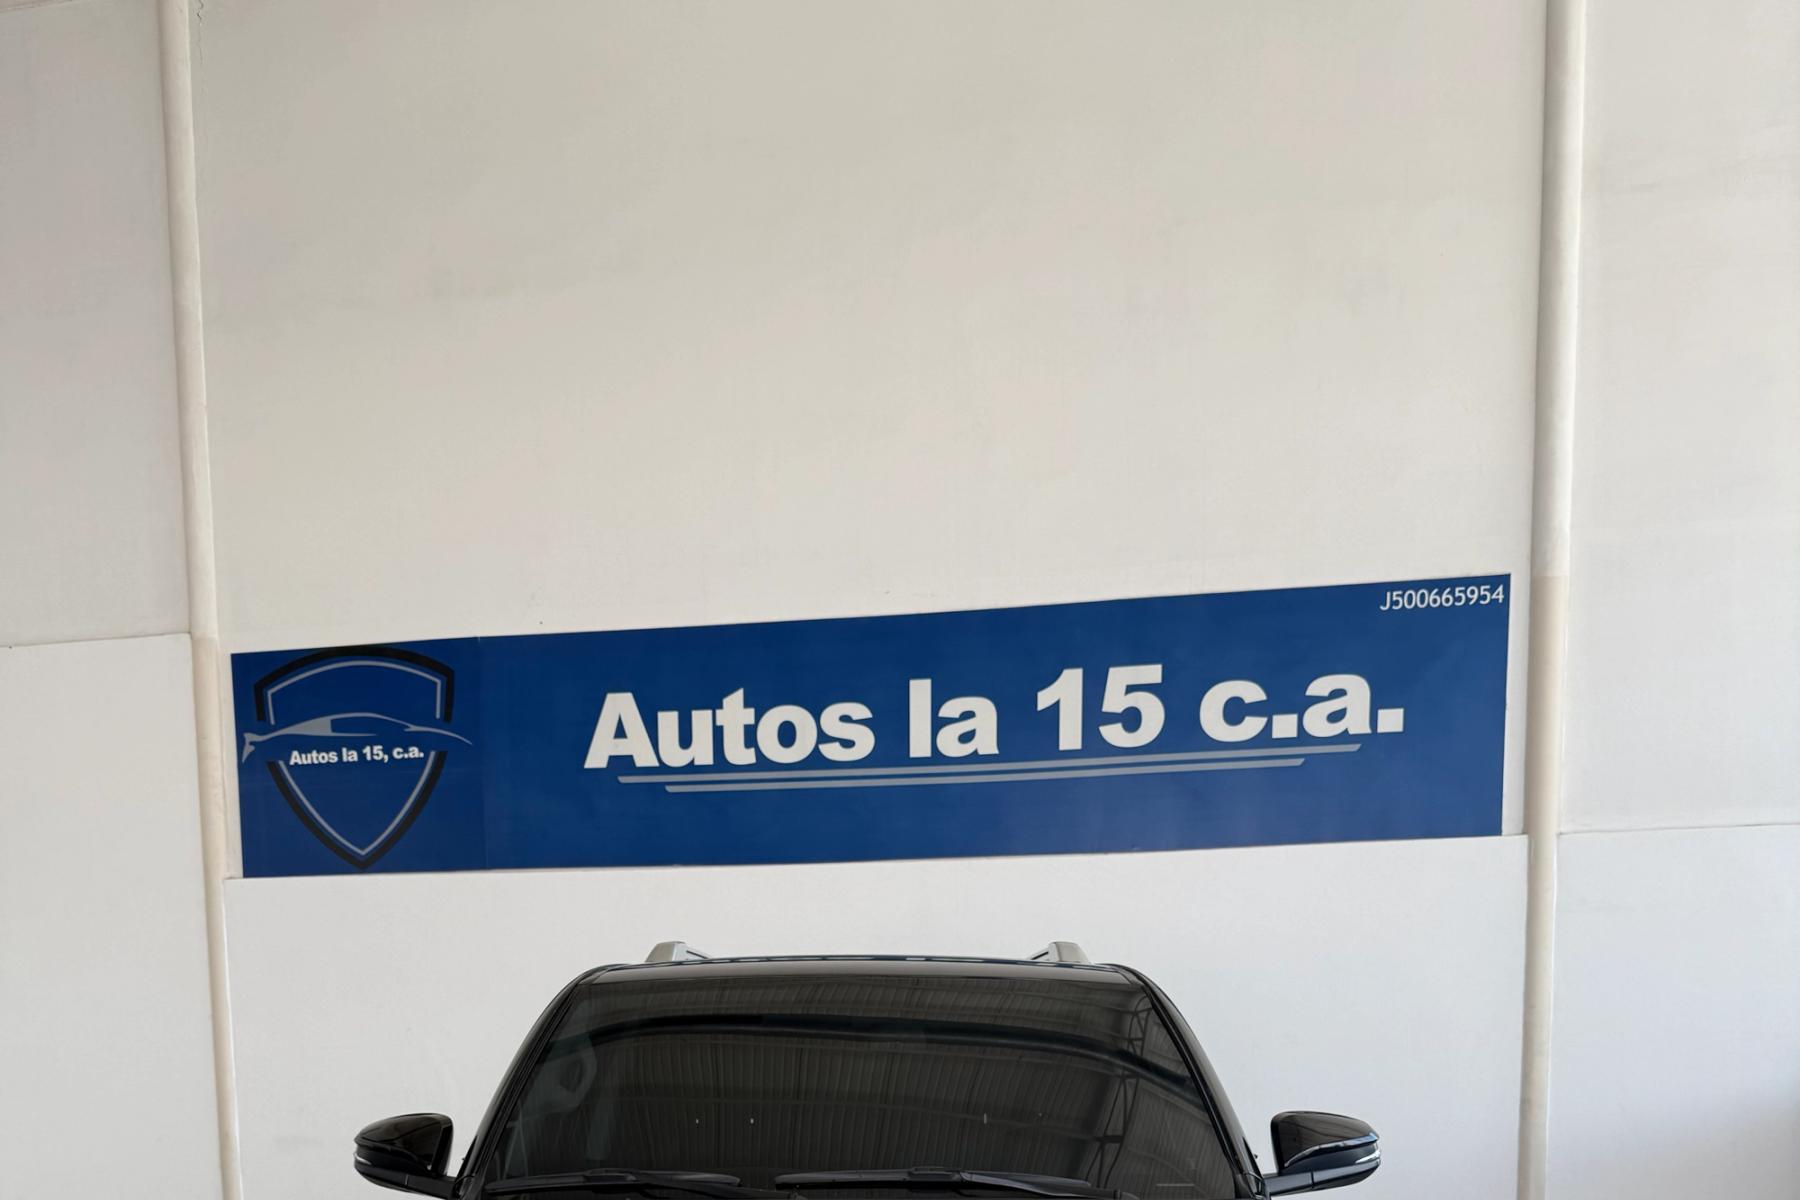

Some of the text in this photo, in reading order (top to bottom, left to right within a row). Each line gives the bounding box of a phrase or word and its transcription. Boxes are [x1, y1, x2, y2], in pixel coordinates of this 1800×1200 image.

[1379, 584, 1504, 611] J500665954
[584, 665, 1404, 769] Autos la 15 c.a.
[289, 745, 424, 766] Autos la 15, c.a.
